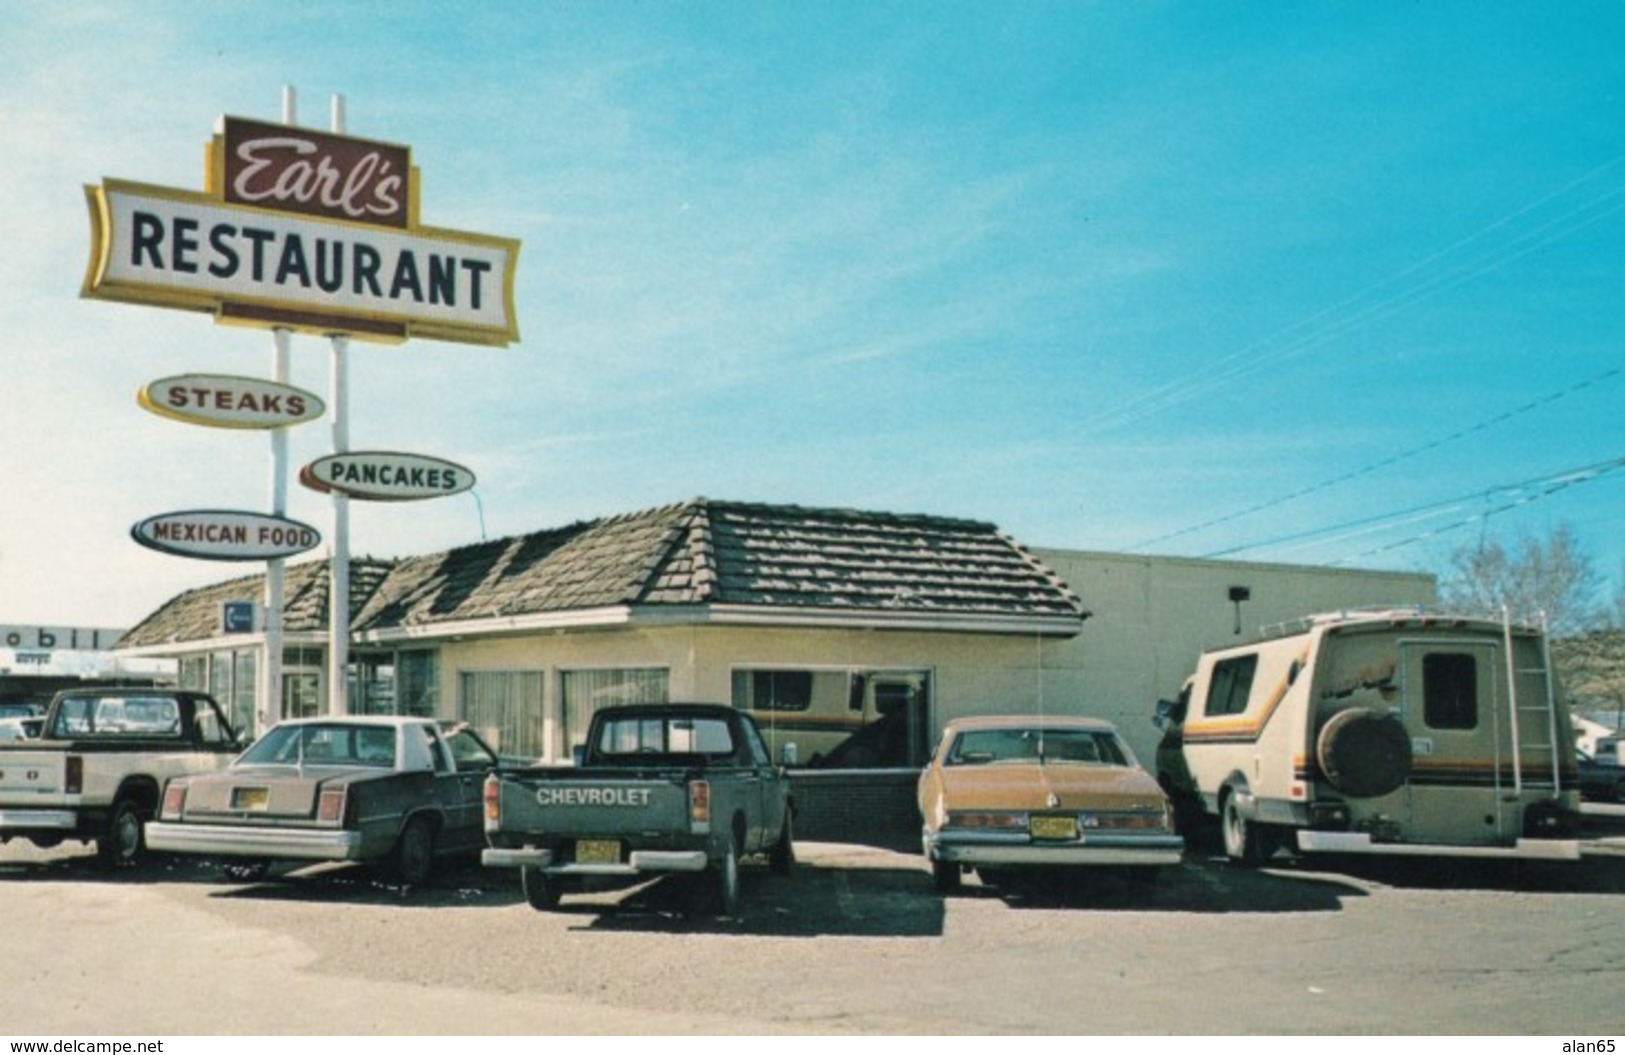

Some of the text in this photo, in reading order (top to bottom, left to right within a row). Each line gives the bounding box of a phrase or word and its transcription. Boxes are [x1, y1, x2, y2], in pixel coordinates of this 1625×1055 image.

[233, 137, 402, 216] Earl's
[130, 210, 492, 310] RESTAURANT
[167, 386, 307, 417] STEAKS
[330, 462, 457, 490] PANCAKES
[153, 521, 313, 548] MEXICAN FOOD
[536, 788, 651, 806] CHEVROLET
